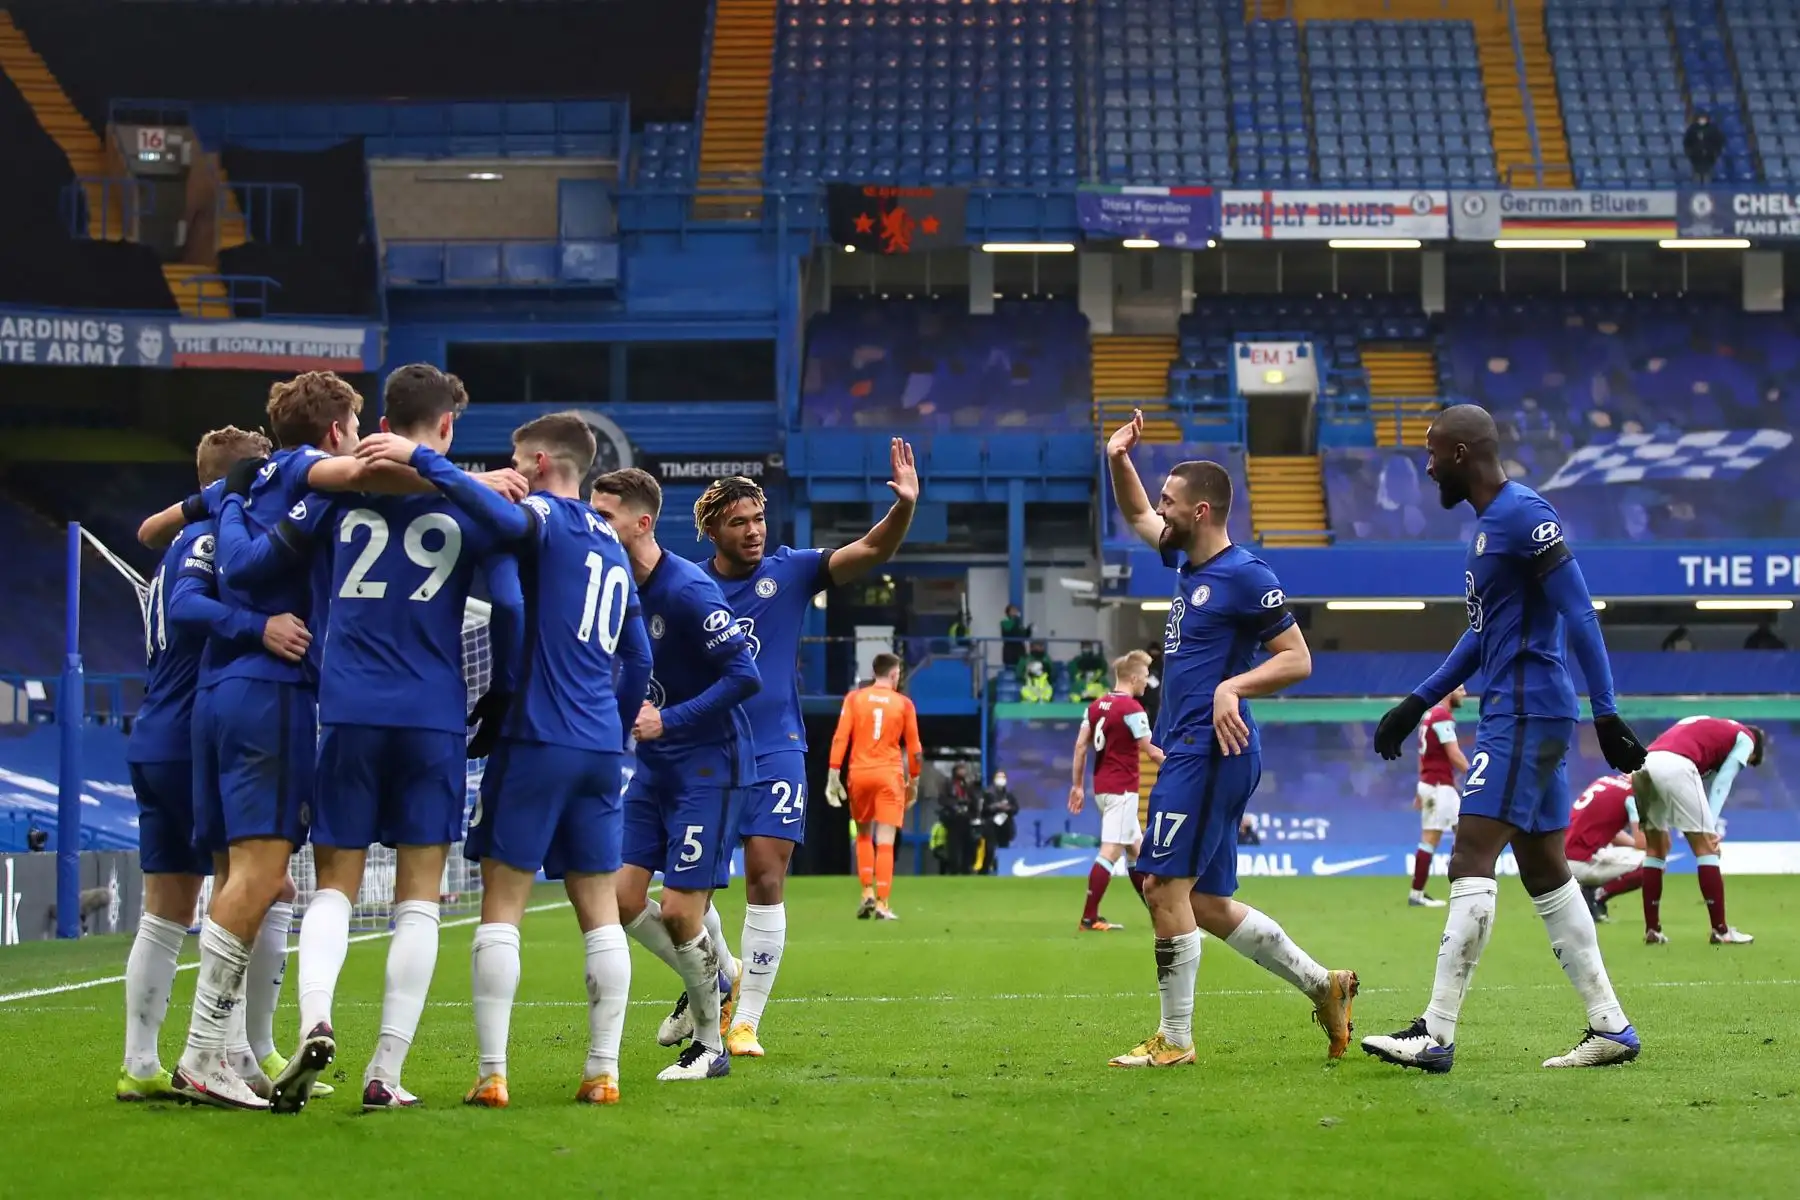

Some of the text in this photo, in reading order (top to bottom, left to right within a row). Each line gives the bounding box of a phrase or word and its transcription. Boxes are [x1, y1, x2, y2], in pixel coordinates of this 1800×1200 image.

[142, 131, 162, 148] 16
[1225, 202, 1395, 226] PHILLY BLUES
[1500, 193, 1649, 213] German Blues
[1, 316, 124, 344] ARDING'S
[0, 340, 124, 366] TE ARMY
[174, 336, 361, 358] THE ROMAN EMPIRE
[1251, 349, 1295, 364] EM 1
[660, 462, 764, 477] TIMEKEEPER
[339, 508, 462, 602] 29
[1679, 556, 1753, 586] THE
[577, 551, 630, 655] 10
[706, 623, 742, 649] HYUND
[873, 707, 884, 740] 1
[1094, 716, 1106, 752] 6
[1466, 752, 1490, 785] 2
[771, 781, 804, 816] 24
[1573, 783, 1607, 811] 5
[1153, 812, 1187, 847] 17
[680, 825, 704, 863] 5
